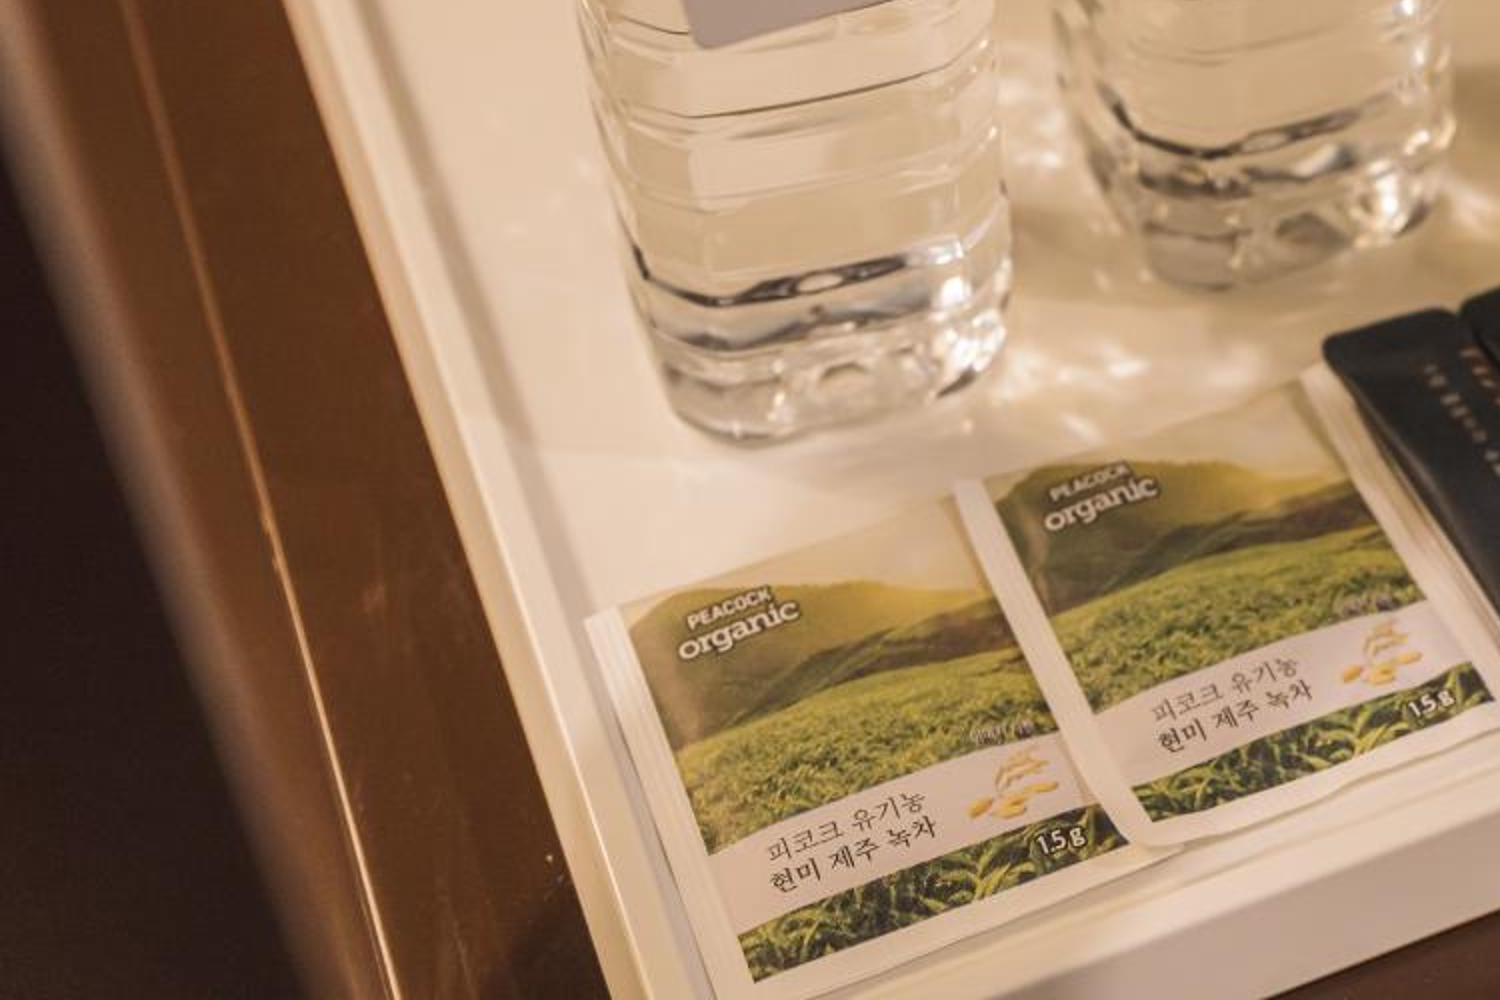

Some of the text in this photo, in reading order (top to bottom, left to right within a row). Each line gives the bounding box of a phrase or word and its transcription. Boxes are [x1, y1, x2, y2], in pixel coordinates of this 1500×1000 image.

[1043, 477, 1159, 532] organic
[678, 601, 800, 660] organic
[686, 586, 773, 631] PEACOCK
[1151, 657, 1297, 722] 피코크 유기농
[1157, 678, 1313, 753] 현미 제주 녹차
[767, 792, 926, 862] 피코크 유기농
[769, 814, 937, 893] 현미 제주 녹차
